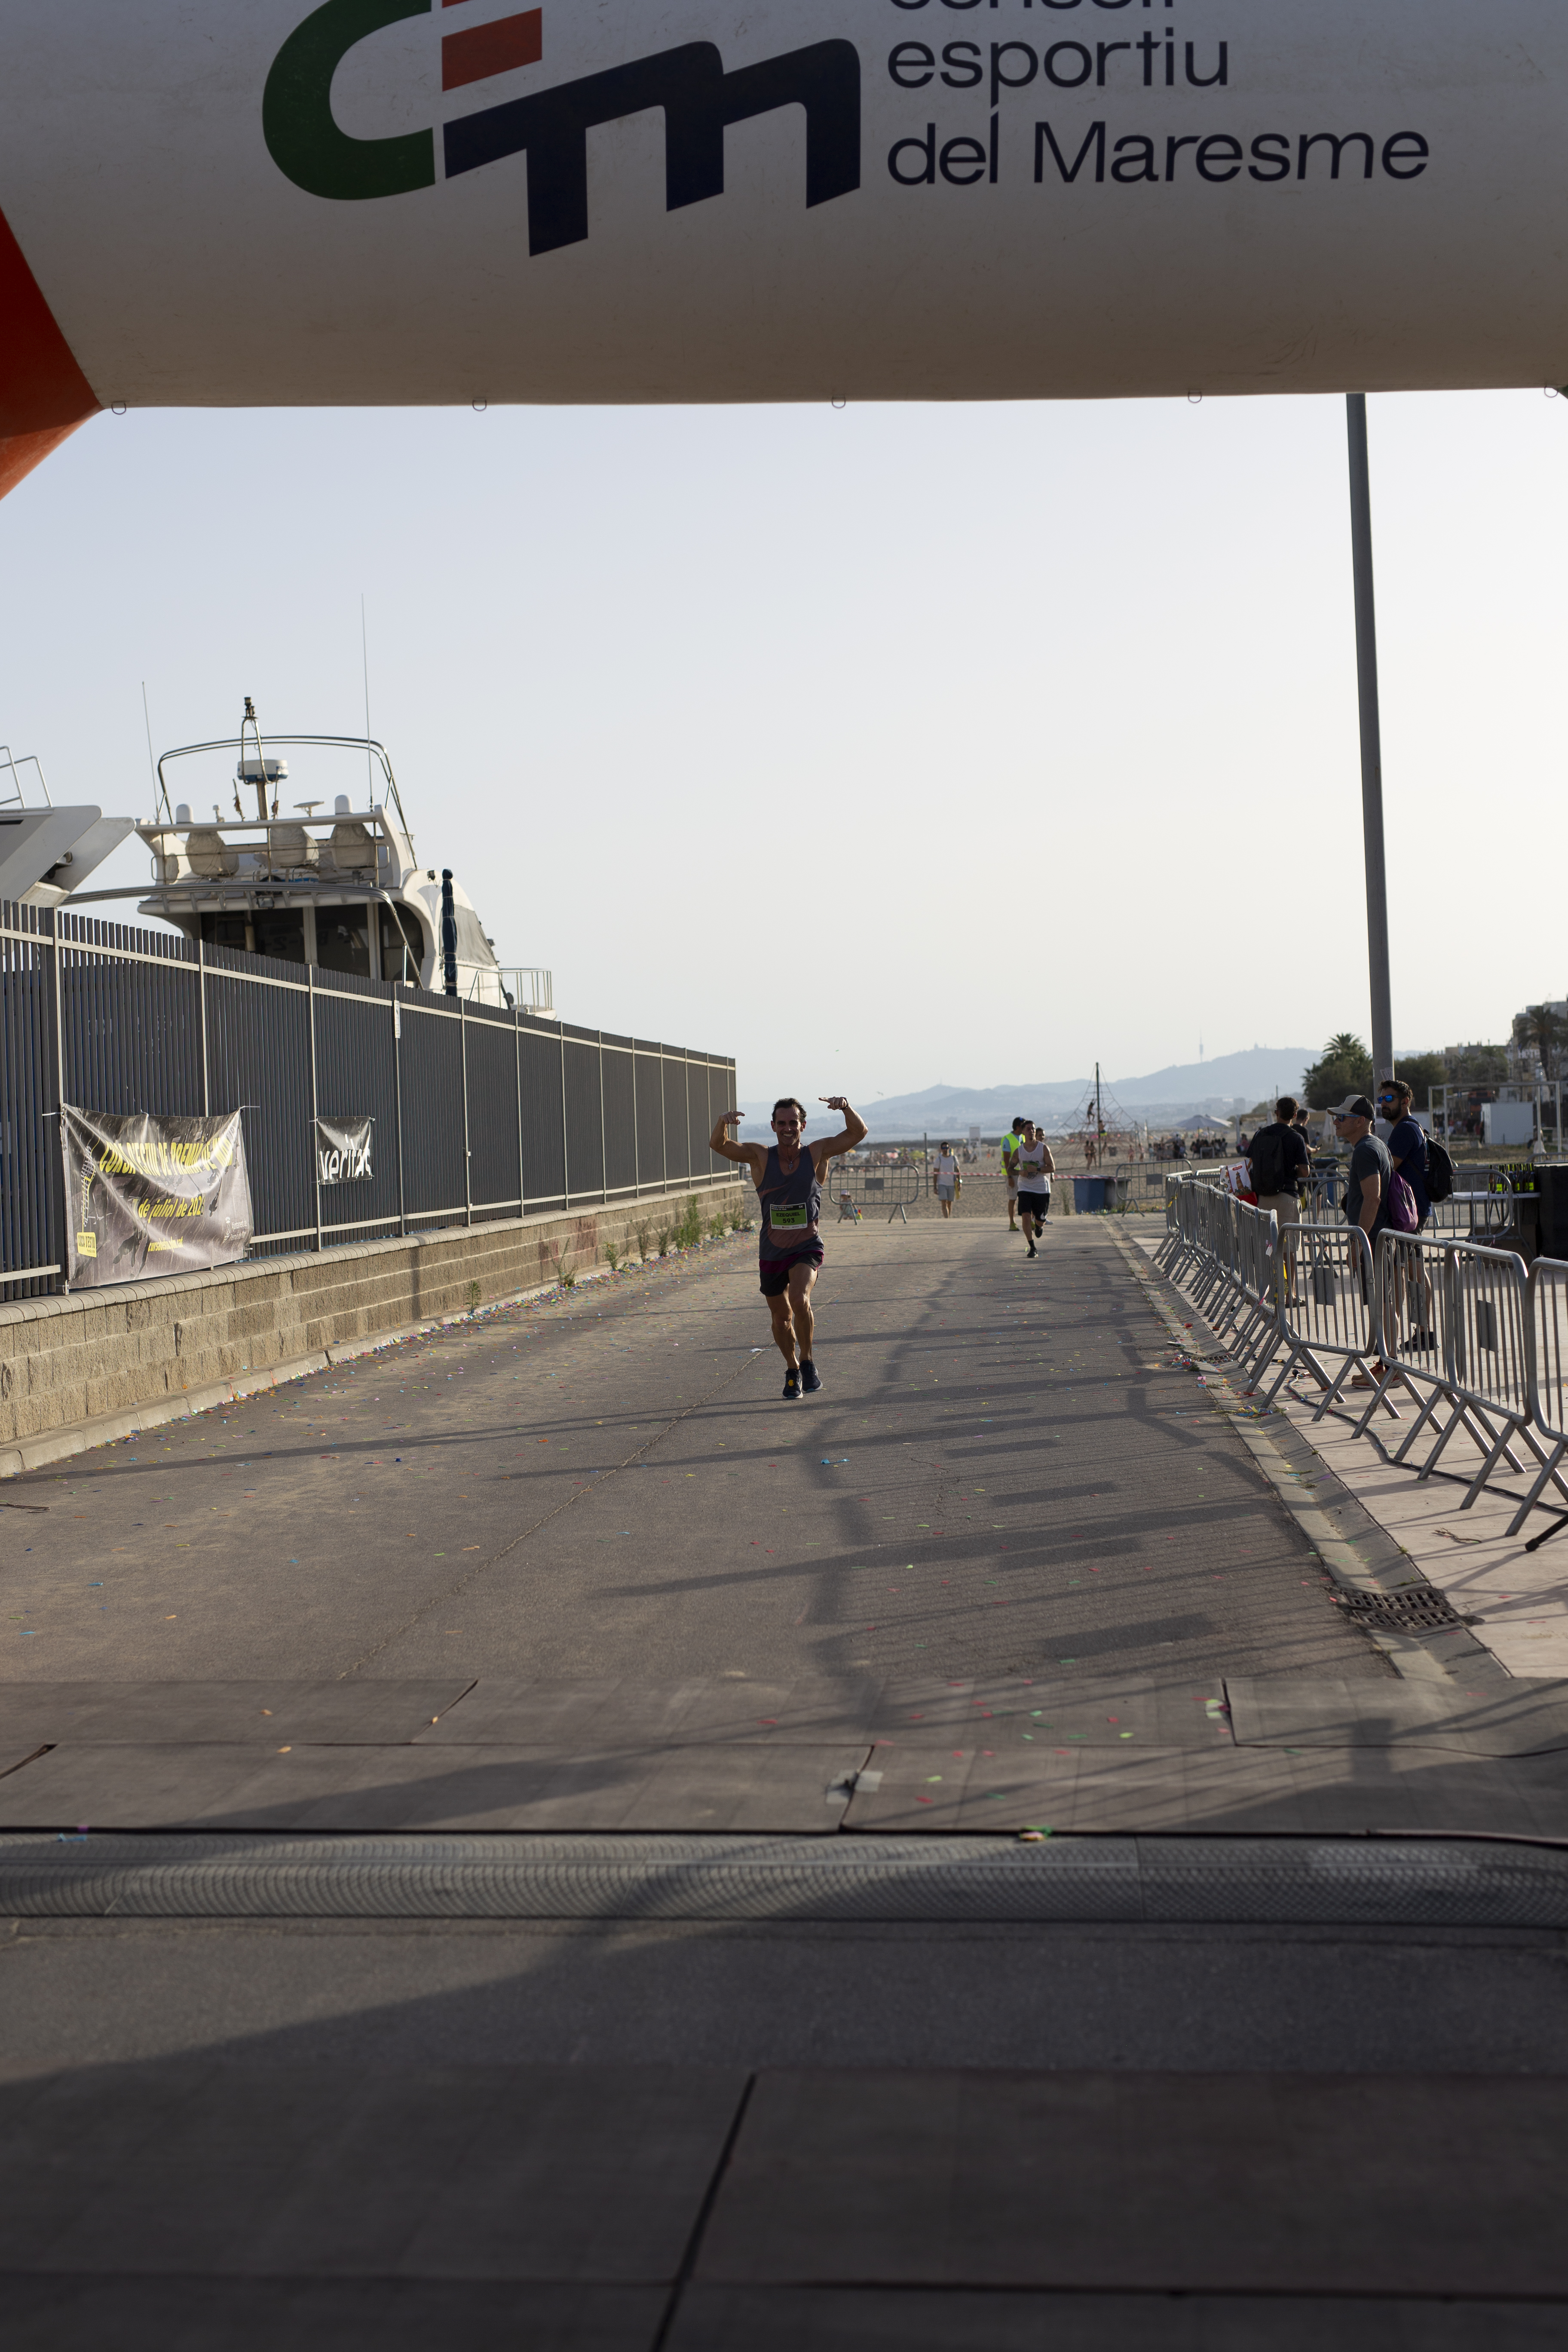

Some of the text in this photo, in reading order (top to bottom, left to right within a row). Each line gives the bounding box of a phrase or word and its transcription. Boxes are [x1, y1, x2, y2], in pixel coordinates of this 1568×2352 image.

[887, 27, 1228, 108] esportiu
[887, 110, 1430, 185] del Maresme
[158, 1142, 172, 1176] DE
[319, 1133, 371, 1180] veritas
[138, 1198, 150, 1217] de
[148, 1198, 178, 1224] juliol
[175, 1197, 187, 1217] de
